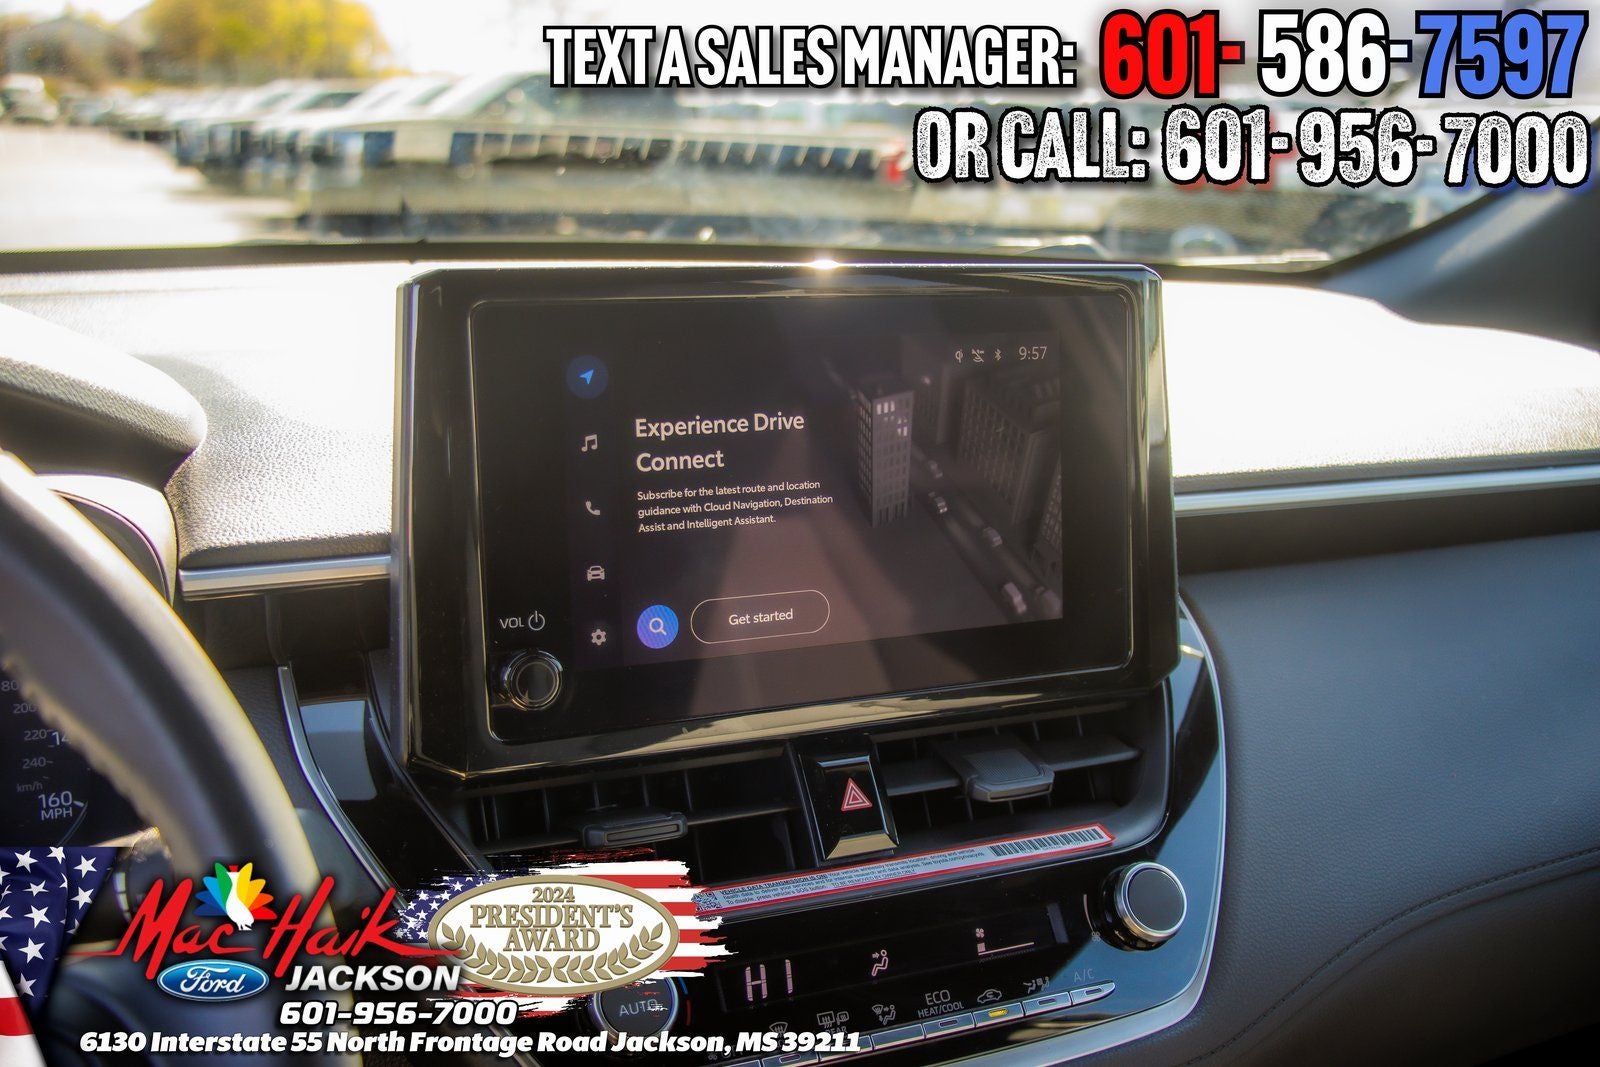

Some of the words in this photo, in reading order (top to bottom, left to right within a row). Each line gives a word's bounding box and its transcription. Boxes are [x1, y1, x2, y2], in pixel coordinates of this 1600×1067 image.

[1018, 346, 1047, 360] 9:57
[635, 415, 749, 440] Experience
[754, 411, 805, 432] Drive
[636, 449, 725, 472] Connect
[637, 489, 683, 500] Subscribe
[684, 488, 697, 497] for
[699, 487, 714, 496] the
[716, 486, 740, 495] latest
[742, 484, 766, 493] route
[767, 482, 785, 491] and
[786, 481, 820, 490] location
[638, 506, 681, 518] guidance
[682, 503, 702, 513] with
[704, 501, 731, 511] Cloud
[733, 499, 783, 510] Navigation,
[784, 495, 833, 506] Destination
[638, 522, 666, 532] Assist
[667, 521, 685, 530] and
[687, 518, 733, 529] Intelligent
[734, 515, 776, 525] Assistant.
[499, 616, 524, 629] VOL
[728, 613, 750, 626] Get
[753, 608, 794, 623] started
[24, 729, 47, 741] 220
[23, 757, 46, 769] 240
[17, 781, 43, 792] km/h
[38, 791, 73, 808] 160
[41, 808, 73, 820] MPH
[720, 887, 745, 895] VEHICLE
[1073, 968, 1095, 983] A/C
[925, 989, 951, 1006] ECO
[619, 998, 658, 1017] AUTO
[917, 1001, 964, 1018] HEAT/COOL
